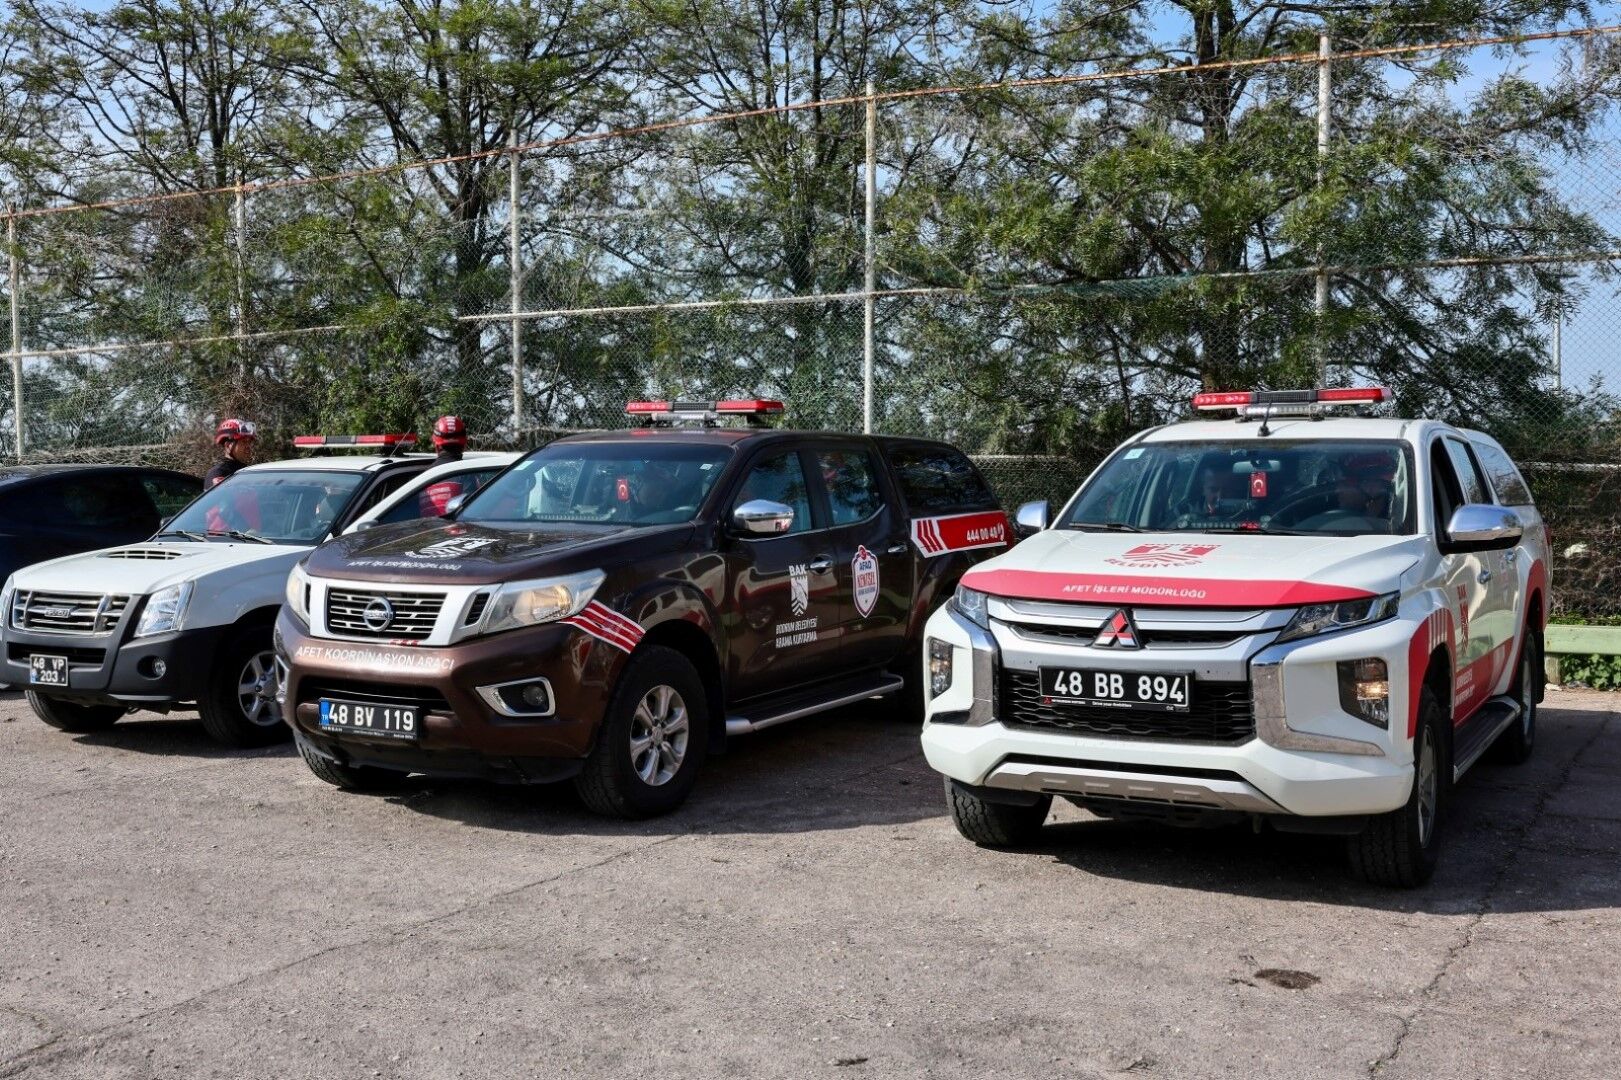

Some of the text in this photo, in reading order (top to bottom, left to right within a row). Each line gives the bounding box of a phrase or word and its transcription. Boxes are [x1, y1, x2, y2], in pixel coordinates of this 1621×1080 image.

[789, 564, 807, 576] BAK
[1062, 583, 1206, 599] AFET İŞLERİ MÜDÜRLÜĞÜ
[33, 657, 64, 670] 48 VP
[295, 646, 455, 670] AFET KOORDİNASYON ARACI
[40, 670, 58, 682] 203
[1054, 670, 1184, 703] 48 BB 894
[329, 703, 414, 732] 48 BV 119
